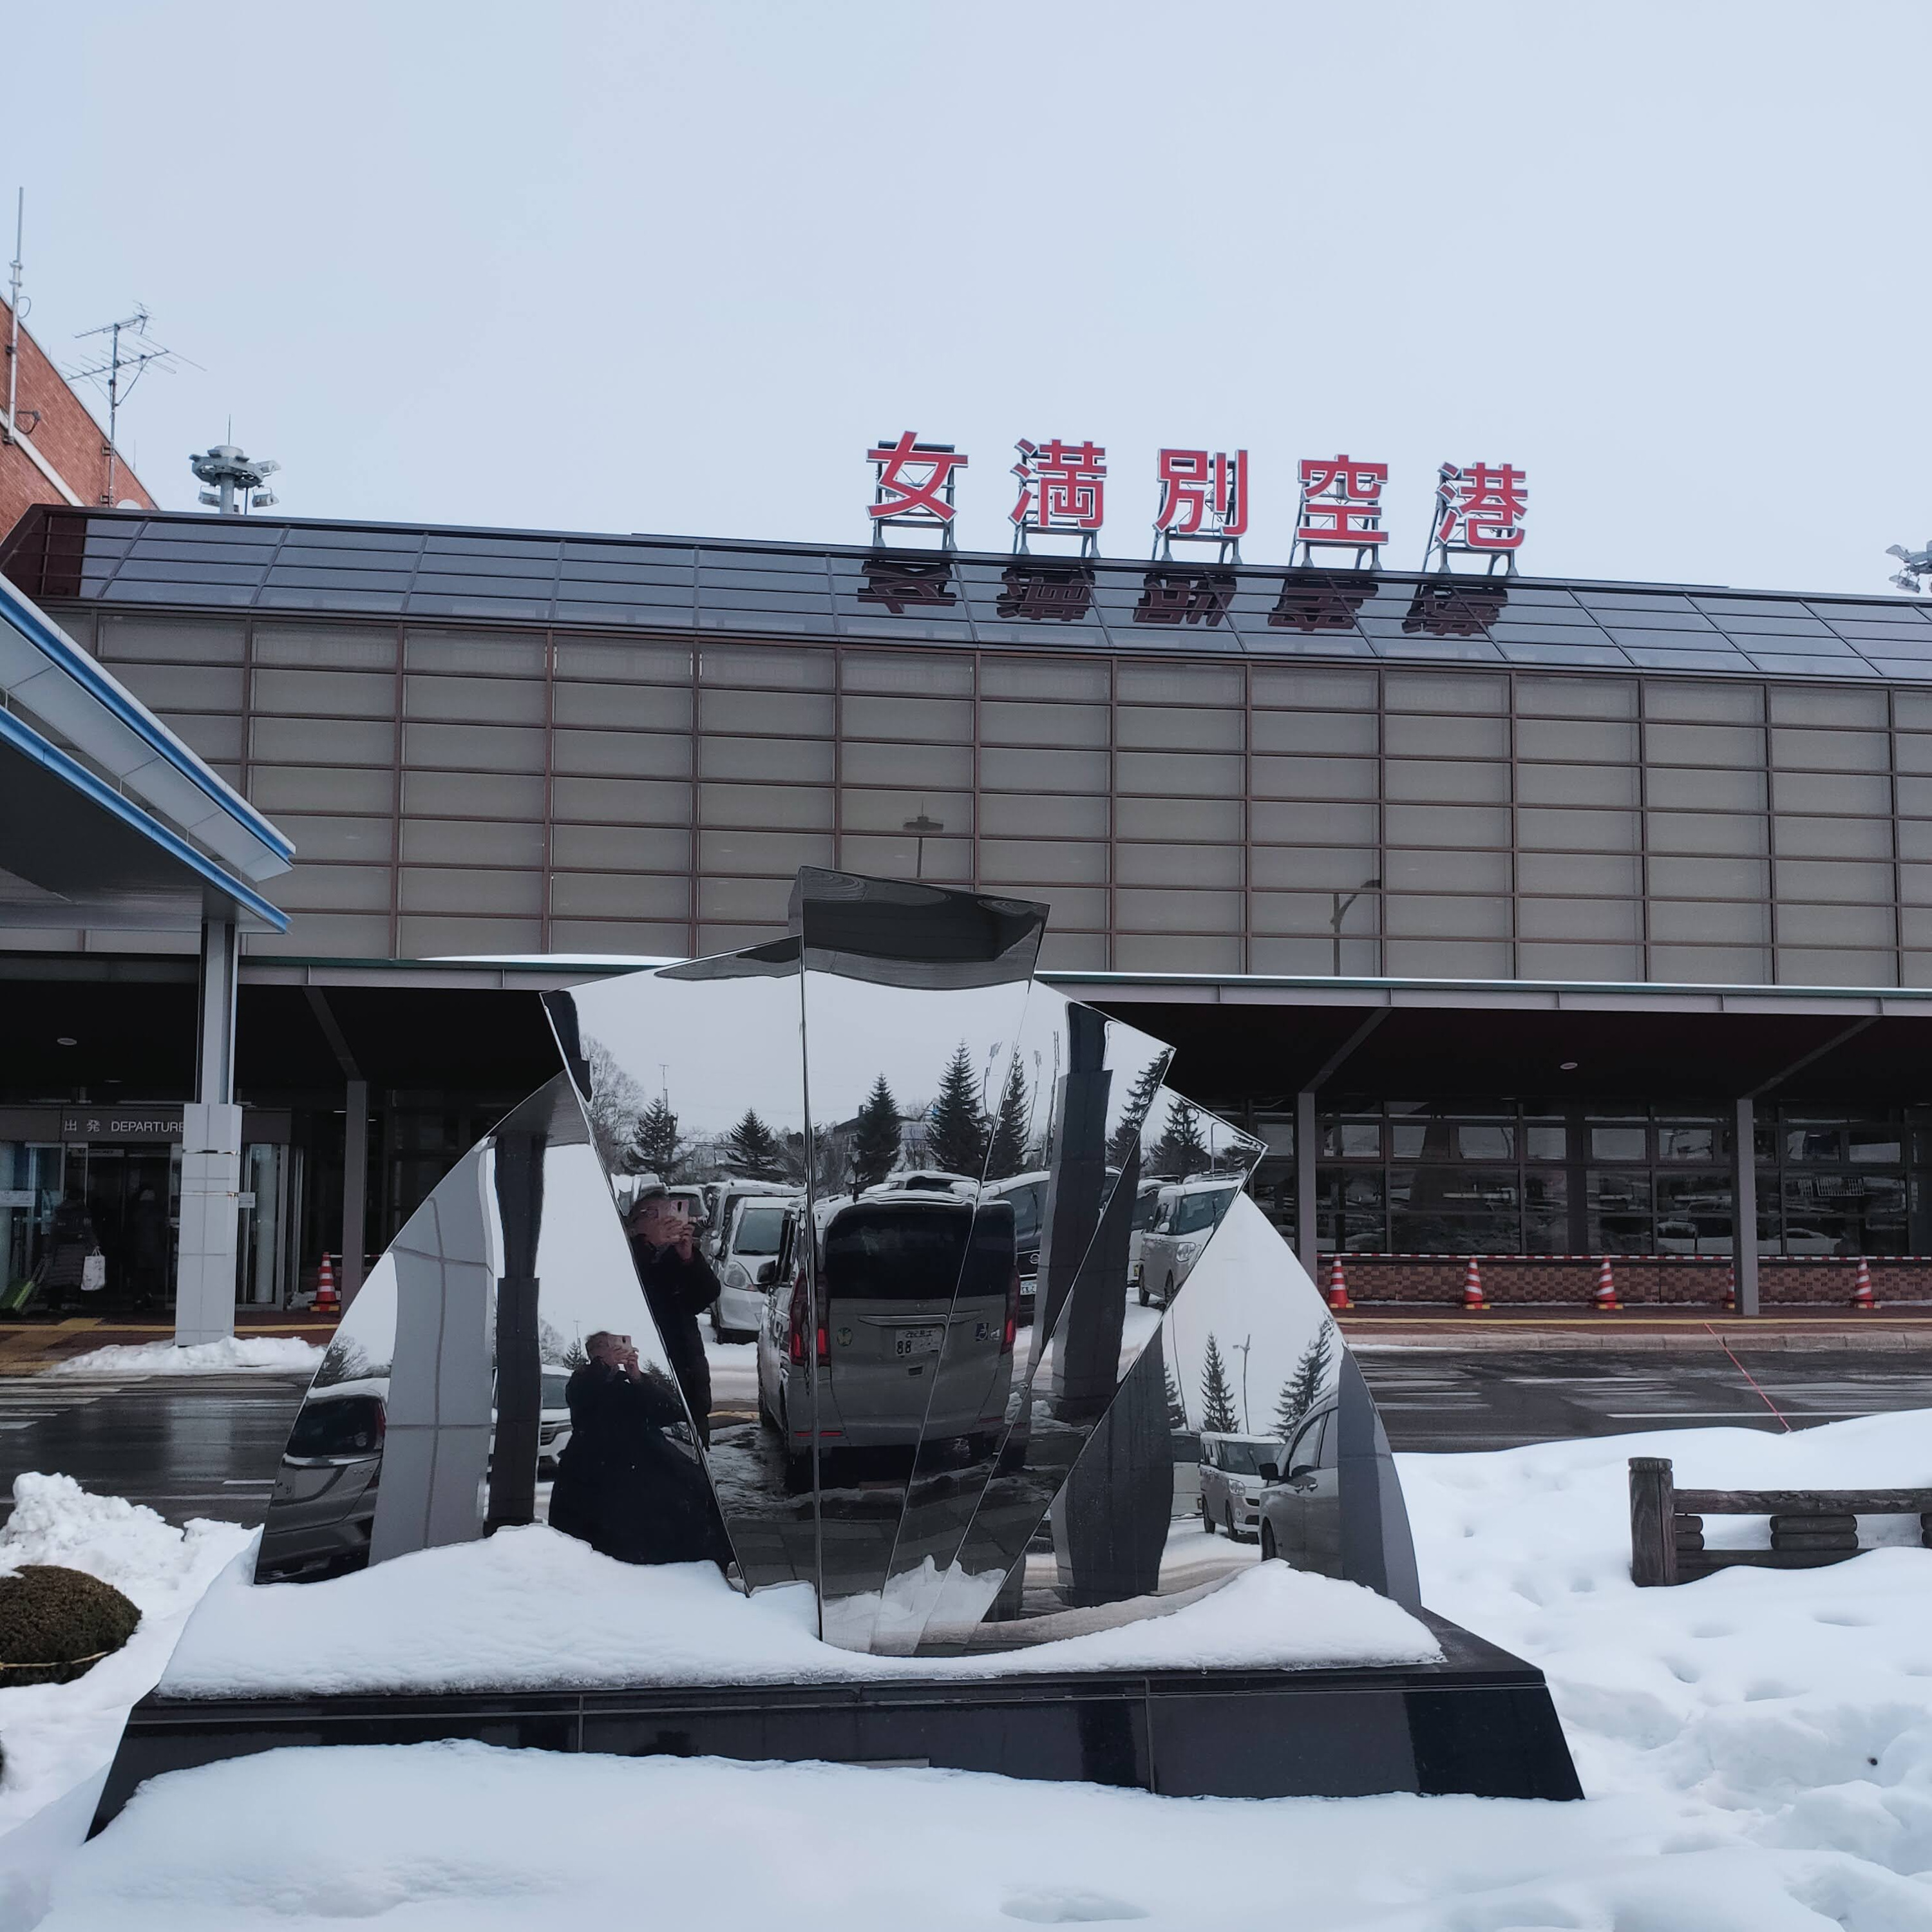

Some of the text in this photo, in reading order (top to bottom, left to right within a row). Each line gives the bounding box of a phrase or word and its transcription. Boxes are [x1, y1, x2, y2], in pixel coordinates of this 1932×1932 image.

[866, 430, 1528, 549] 女満別空港
